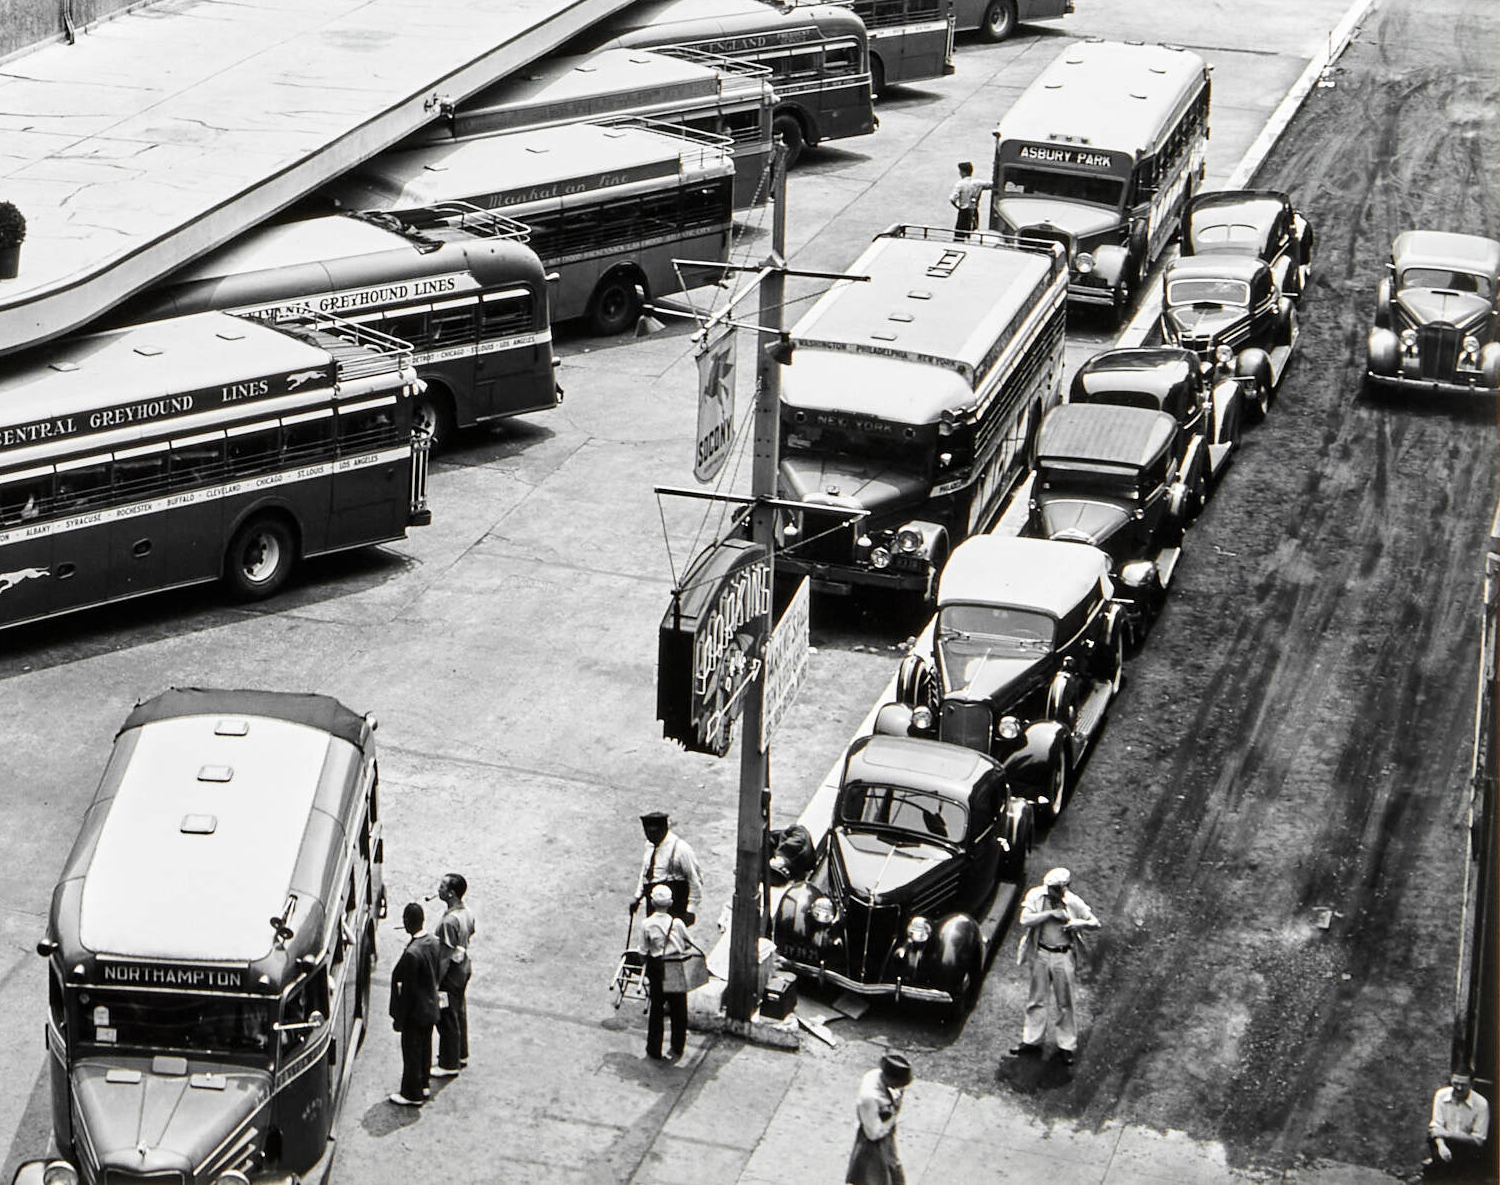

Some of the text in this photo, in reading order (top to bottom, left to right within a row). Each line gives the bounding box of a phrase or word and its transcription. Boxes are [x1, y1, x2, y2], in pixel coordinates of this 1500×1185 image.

[709, 37, 766, 53] ENGLAND
[1020, 146, 1111, 167] ASBURY PARK
[319, 285, 408, 311] GREYHOUND
[414, 278, 456, 295] LINES
[441, 349, 465, 359] CHICAGO
[799, 339, 846, 351] WASHINGTON
[856, 345, 908, 359] PHILADELPHIA
[935, 355, 956, 367] YORK
[89, 395, 193, 429] GREYHOUND
[221, 380, 269, 402] LINES
[856, 421, 892, 433] YORK
[698, 415, 732, 467] SOCONY
[26, 525, 51, 537] ALBANY
[65, 514, 101, 528] SYRACUSE
[116, 502, 152, 520] ROCHESTER
[167, 494, 195, 507] BUFFALO
[206, 484, 241, 498] CLEVELAND
[256, 475, 283, 487] CHICAGO
[339, 460, 350, 470] LOS
[354, 455, 378, 466] ANGELES
[104, 966, 242, 986] NORTHAMPTON
